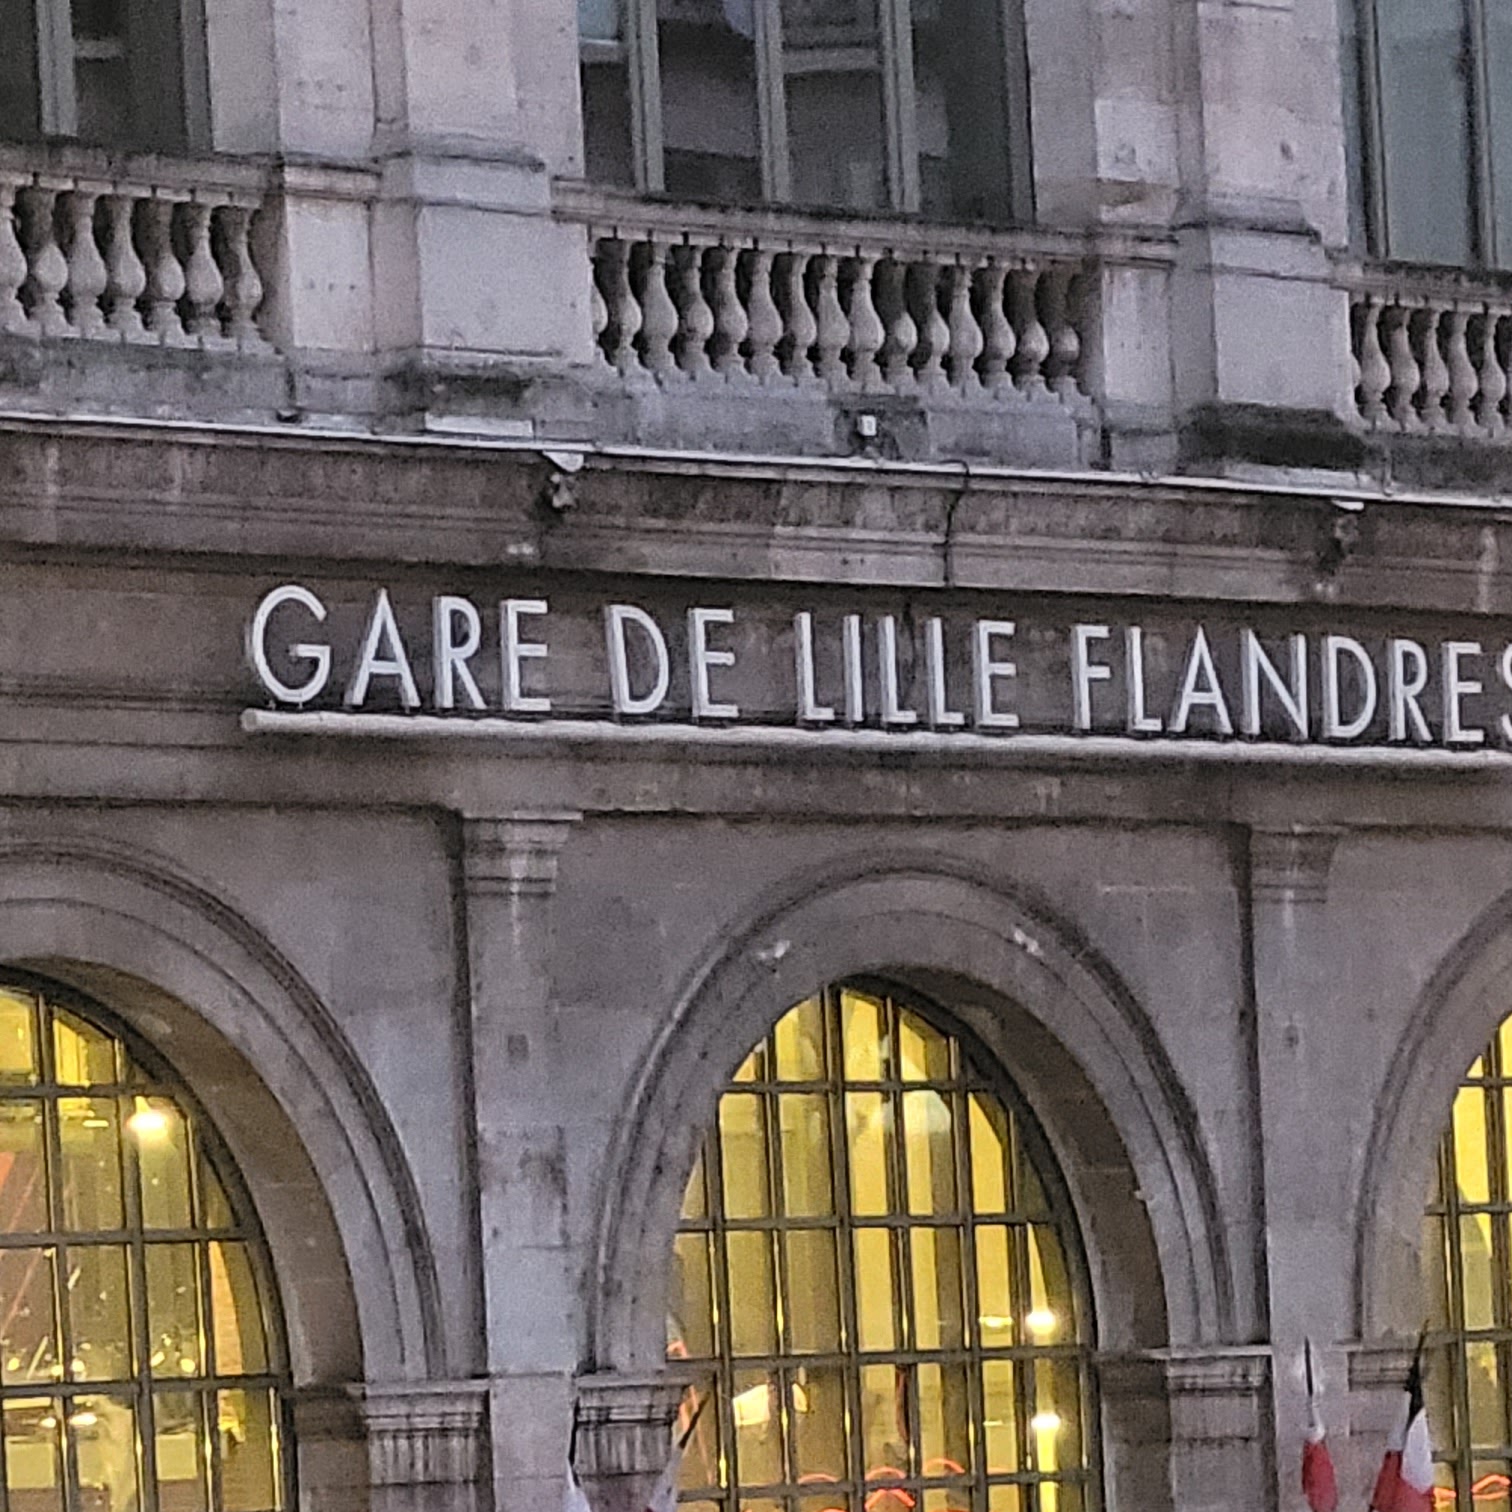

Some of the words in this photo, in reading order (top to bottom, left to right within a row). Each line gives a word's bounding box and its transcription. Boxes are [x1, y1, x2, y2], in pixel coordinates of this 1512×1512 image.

[249, 584, 551, 712] GARE
[605, 604, 739, 719] DE
[794, 611, 1020, 728] LILLE
